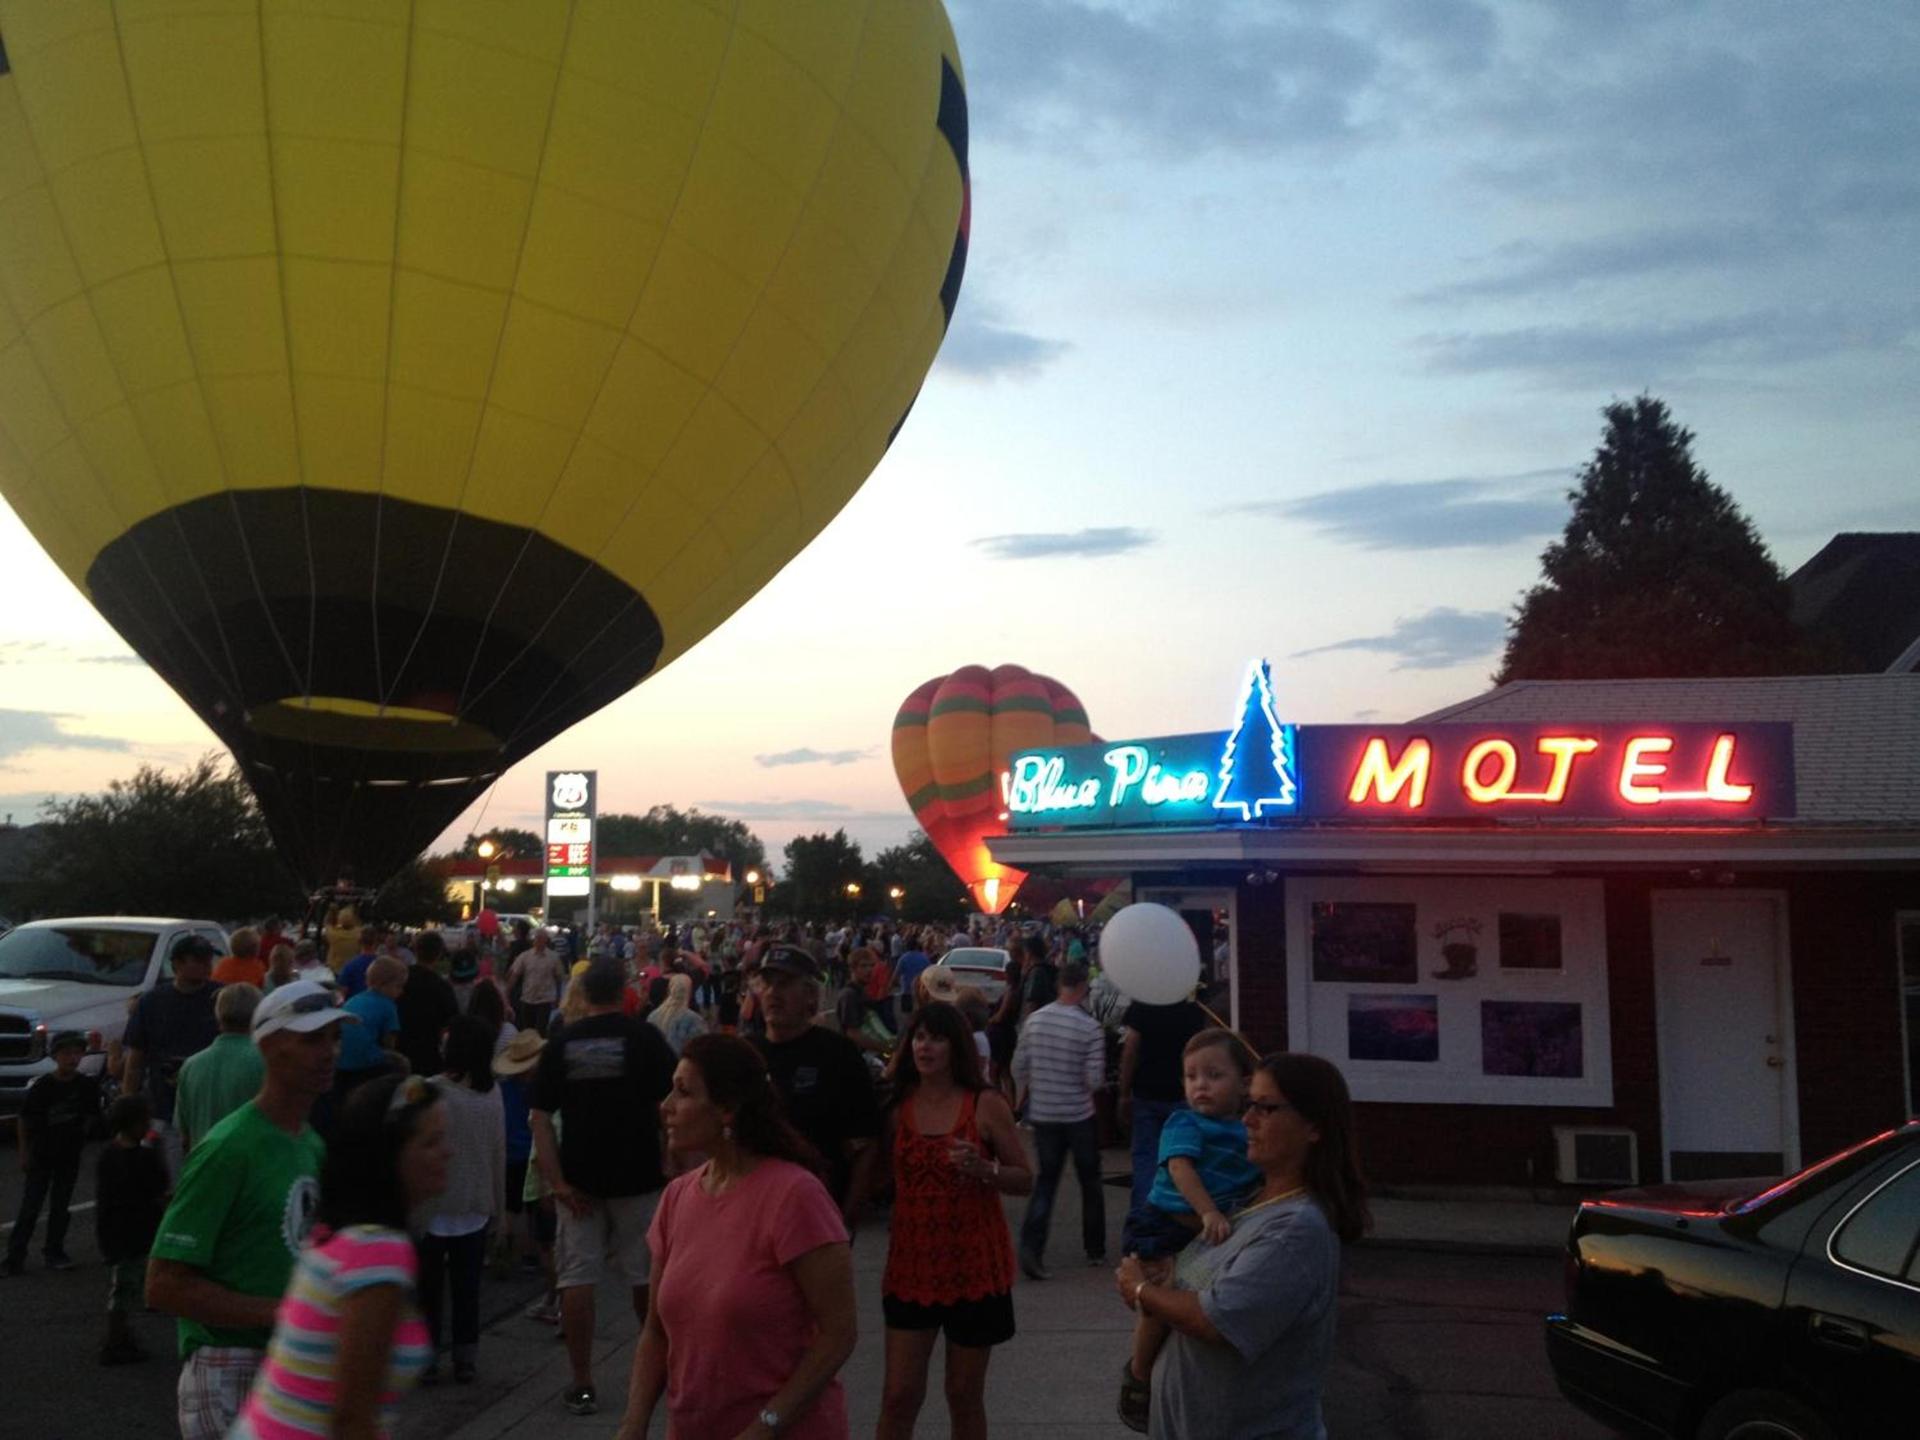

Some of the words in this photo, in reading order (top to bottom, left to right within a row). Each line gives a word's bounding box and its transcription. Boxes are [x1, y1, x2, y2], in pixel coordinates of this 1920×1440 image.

[1009, 755, 1101, 814] Blue
[1104, 745, 1211, 808] Pine
[1347, 733, 1756, 808] MOTEL
